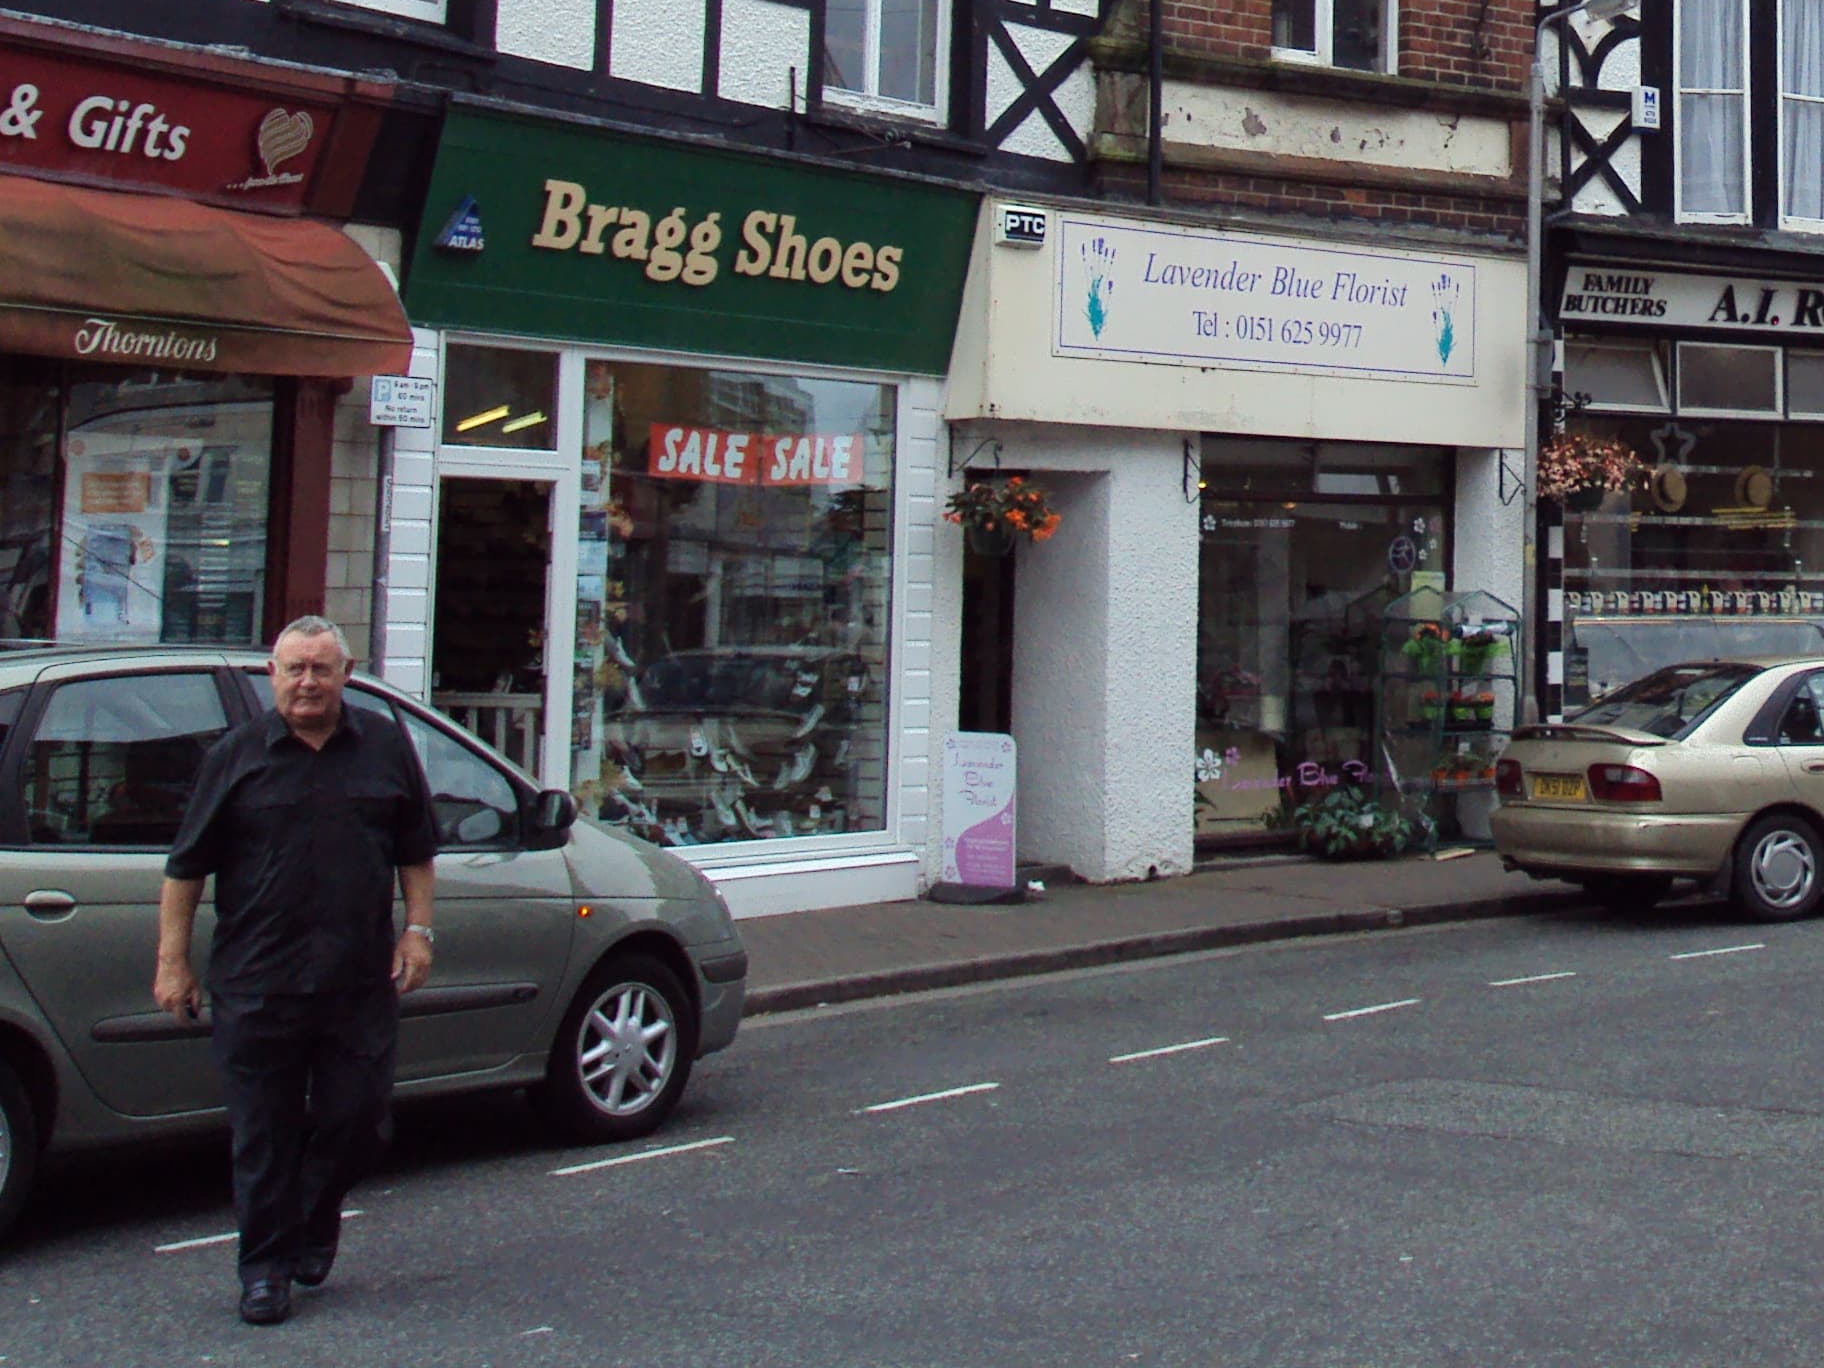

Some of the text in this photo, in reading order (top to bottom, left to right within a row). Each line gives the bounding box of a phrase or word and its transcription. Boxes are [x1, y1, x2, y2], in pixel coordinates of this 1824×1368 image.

[0, 84, 191, 161] & Gifts
[448, 235, 484, 250] ATLAS
[532, 179, 903, 292] Bragg Shoes
[1006, 214, 1044, 234] PTC
[1143, 252, 1408, 307] Lavender Blue Florist
[1583, 273, 1656, 295] FAMILY
[1564, 294, 1667, 317] BUTCHERS
[75, 318, 217, 361] Thorntons
[1192, 311, 1218, 337] Tel
[1236, 315, 1273, 342] 0151
[1281, 319, 1313, 344] 625
[1319, 321, 1363, 349] 9977
[658, 428, 854, 480] SALE SALE
